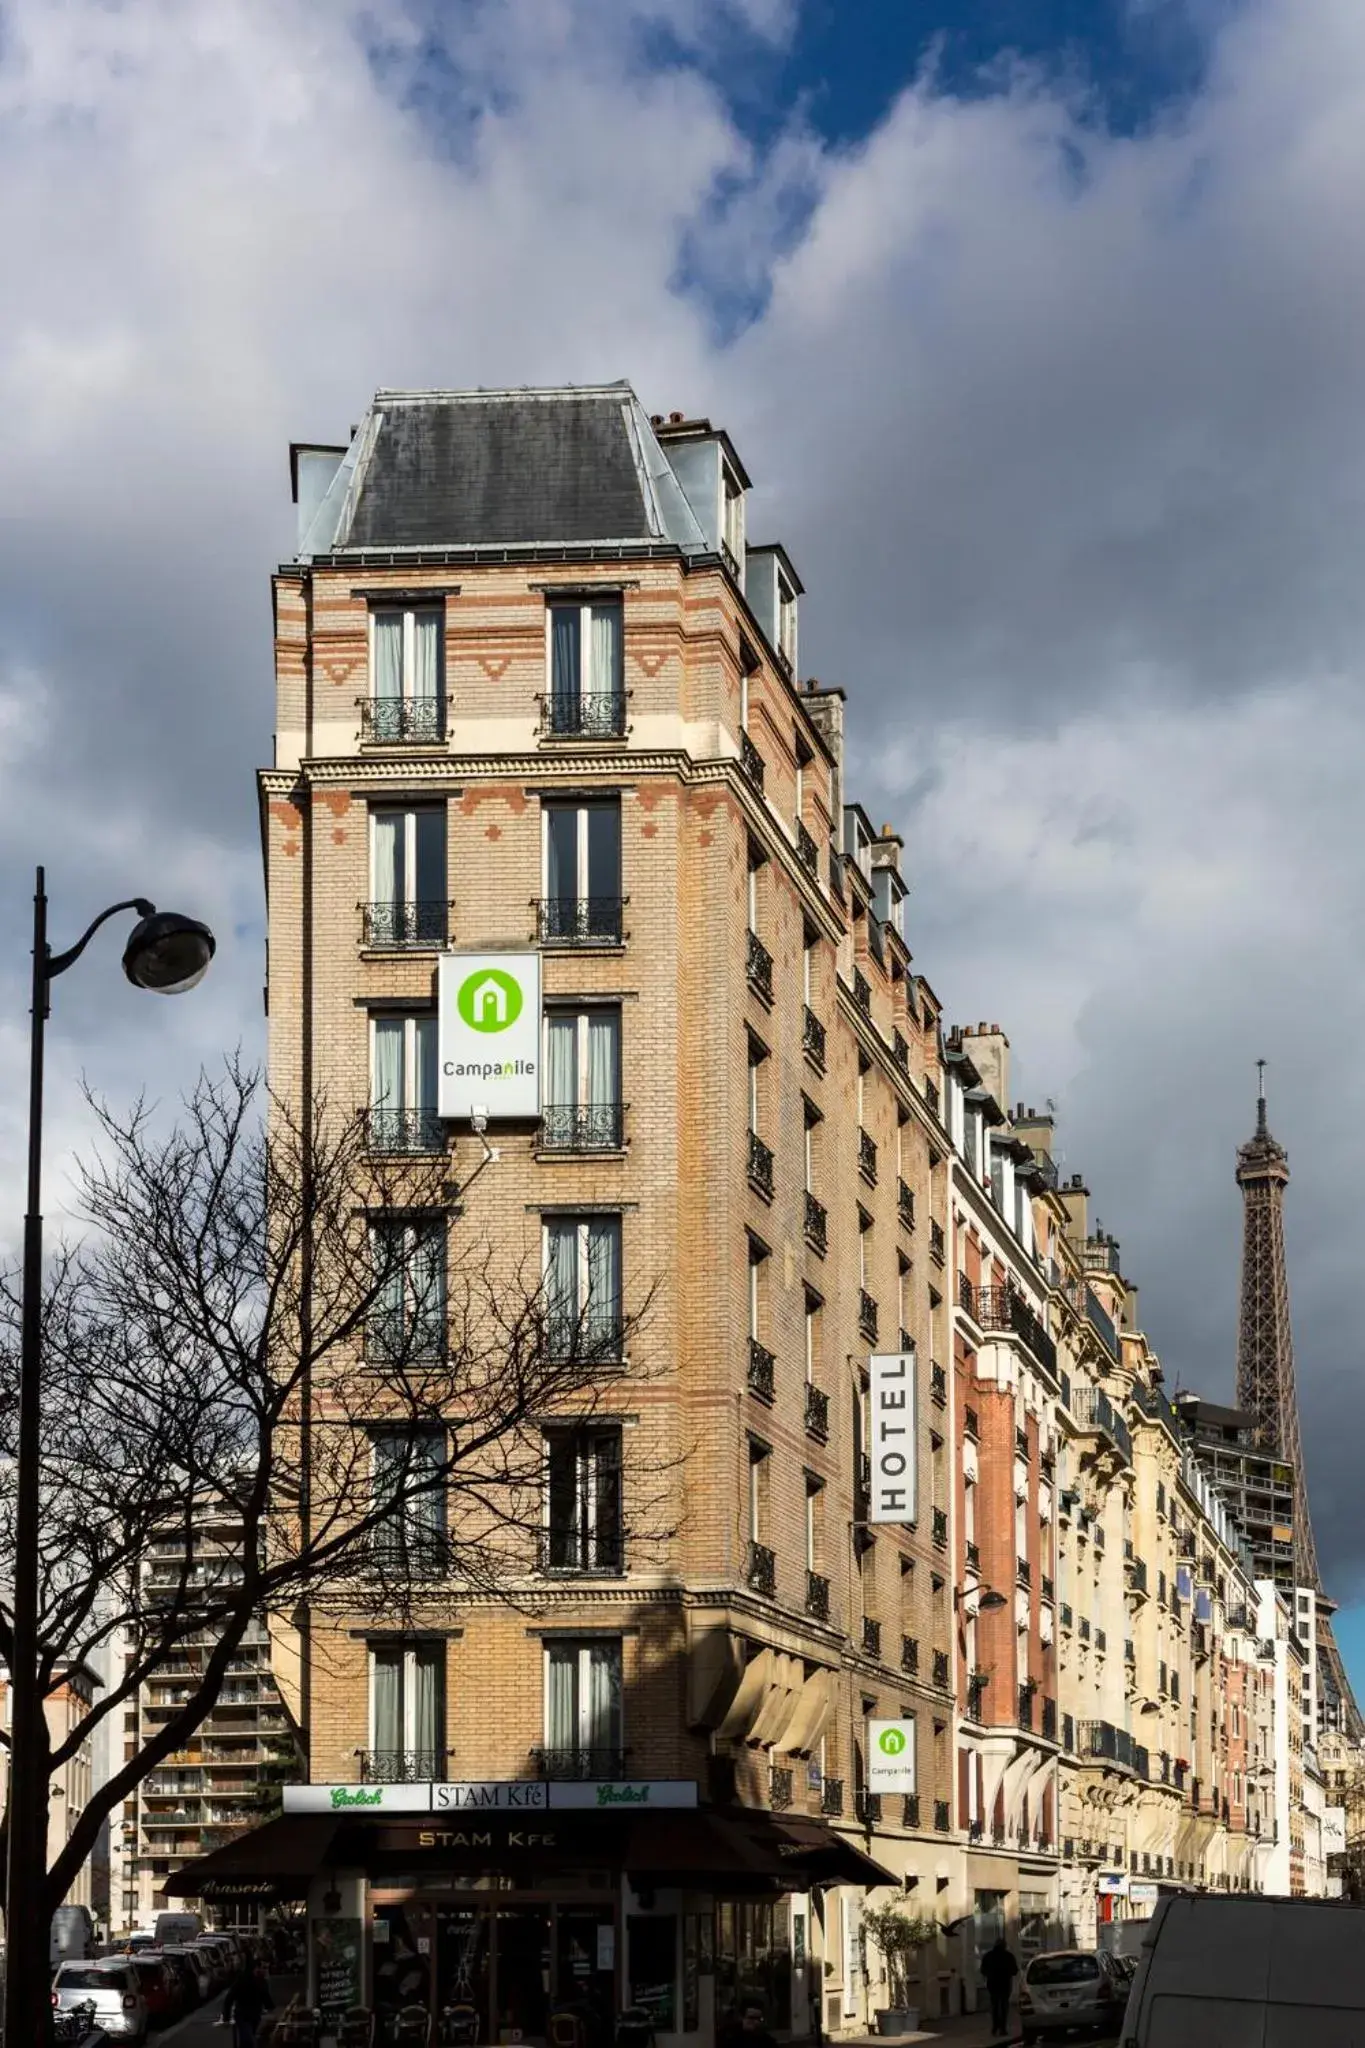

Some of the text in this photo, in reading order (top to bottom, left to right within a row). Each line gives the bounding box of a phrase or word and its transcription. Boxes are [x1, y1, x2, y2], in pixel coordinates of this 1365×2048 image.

[443, 1060, 535, 1080] Campanile
[881, 1360, 906, 1510] HOTEL
[330, 1787, 383, 1808] Grolsch
[438, 1784, 542, 1807] STAM Kfé
[596, 1784, 650, 1805] Grolsch
[418, 1831, 492, 1847] STAM
